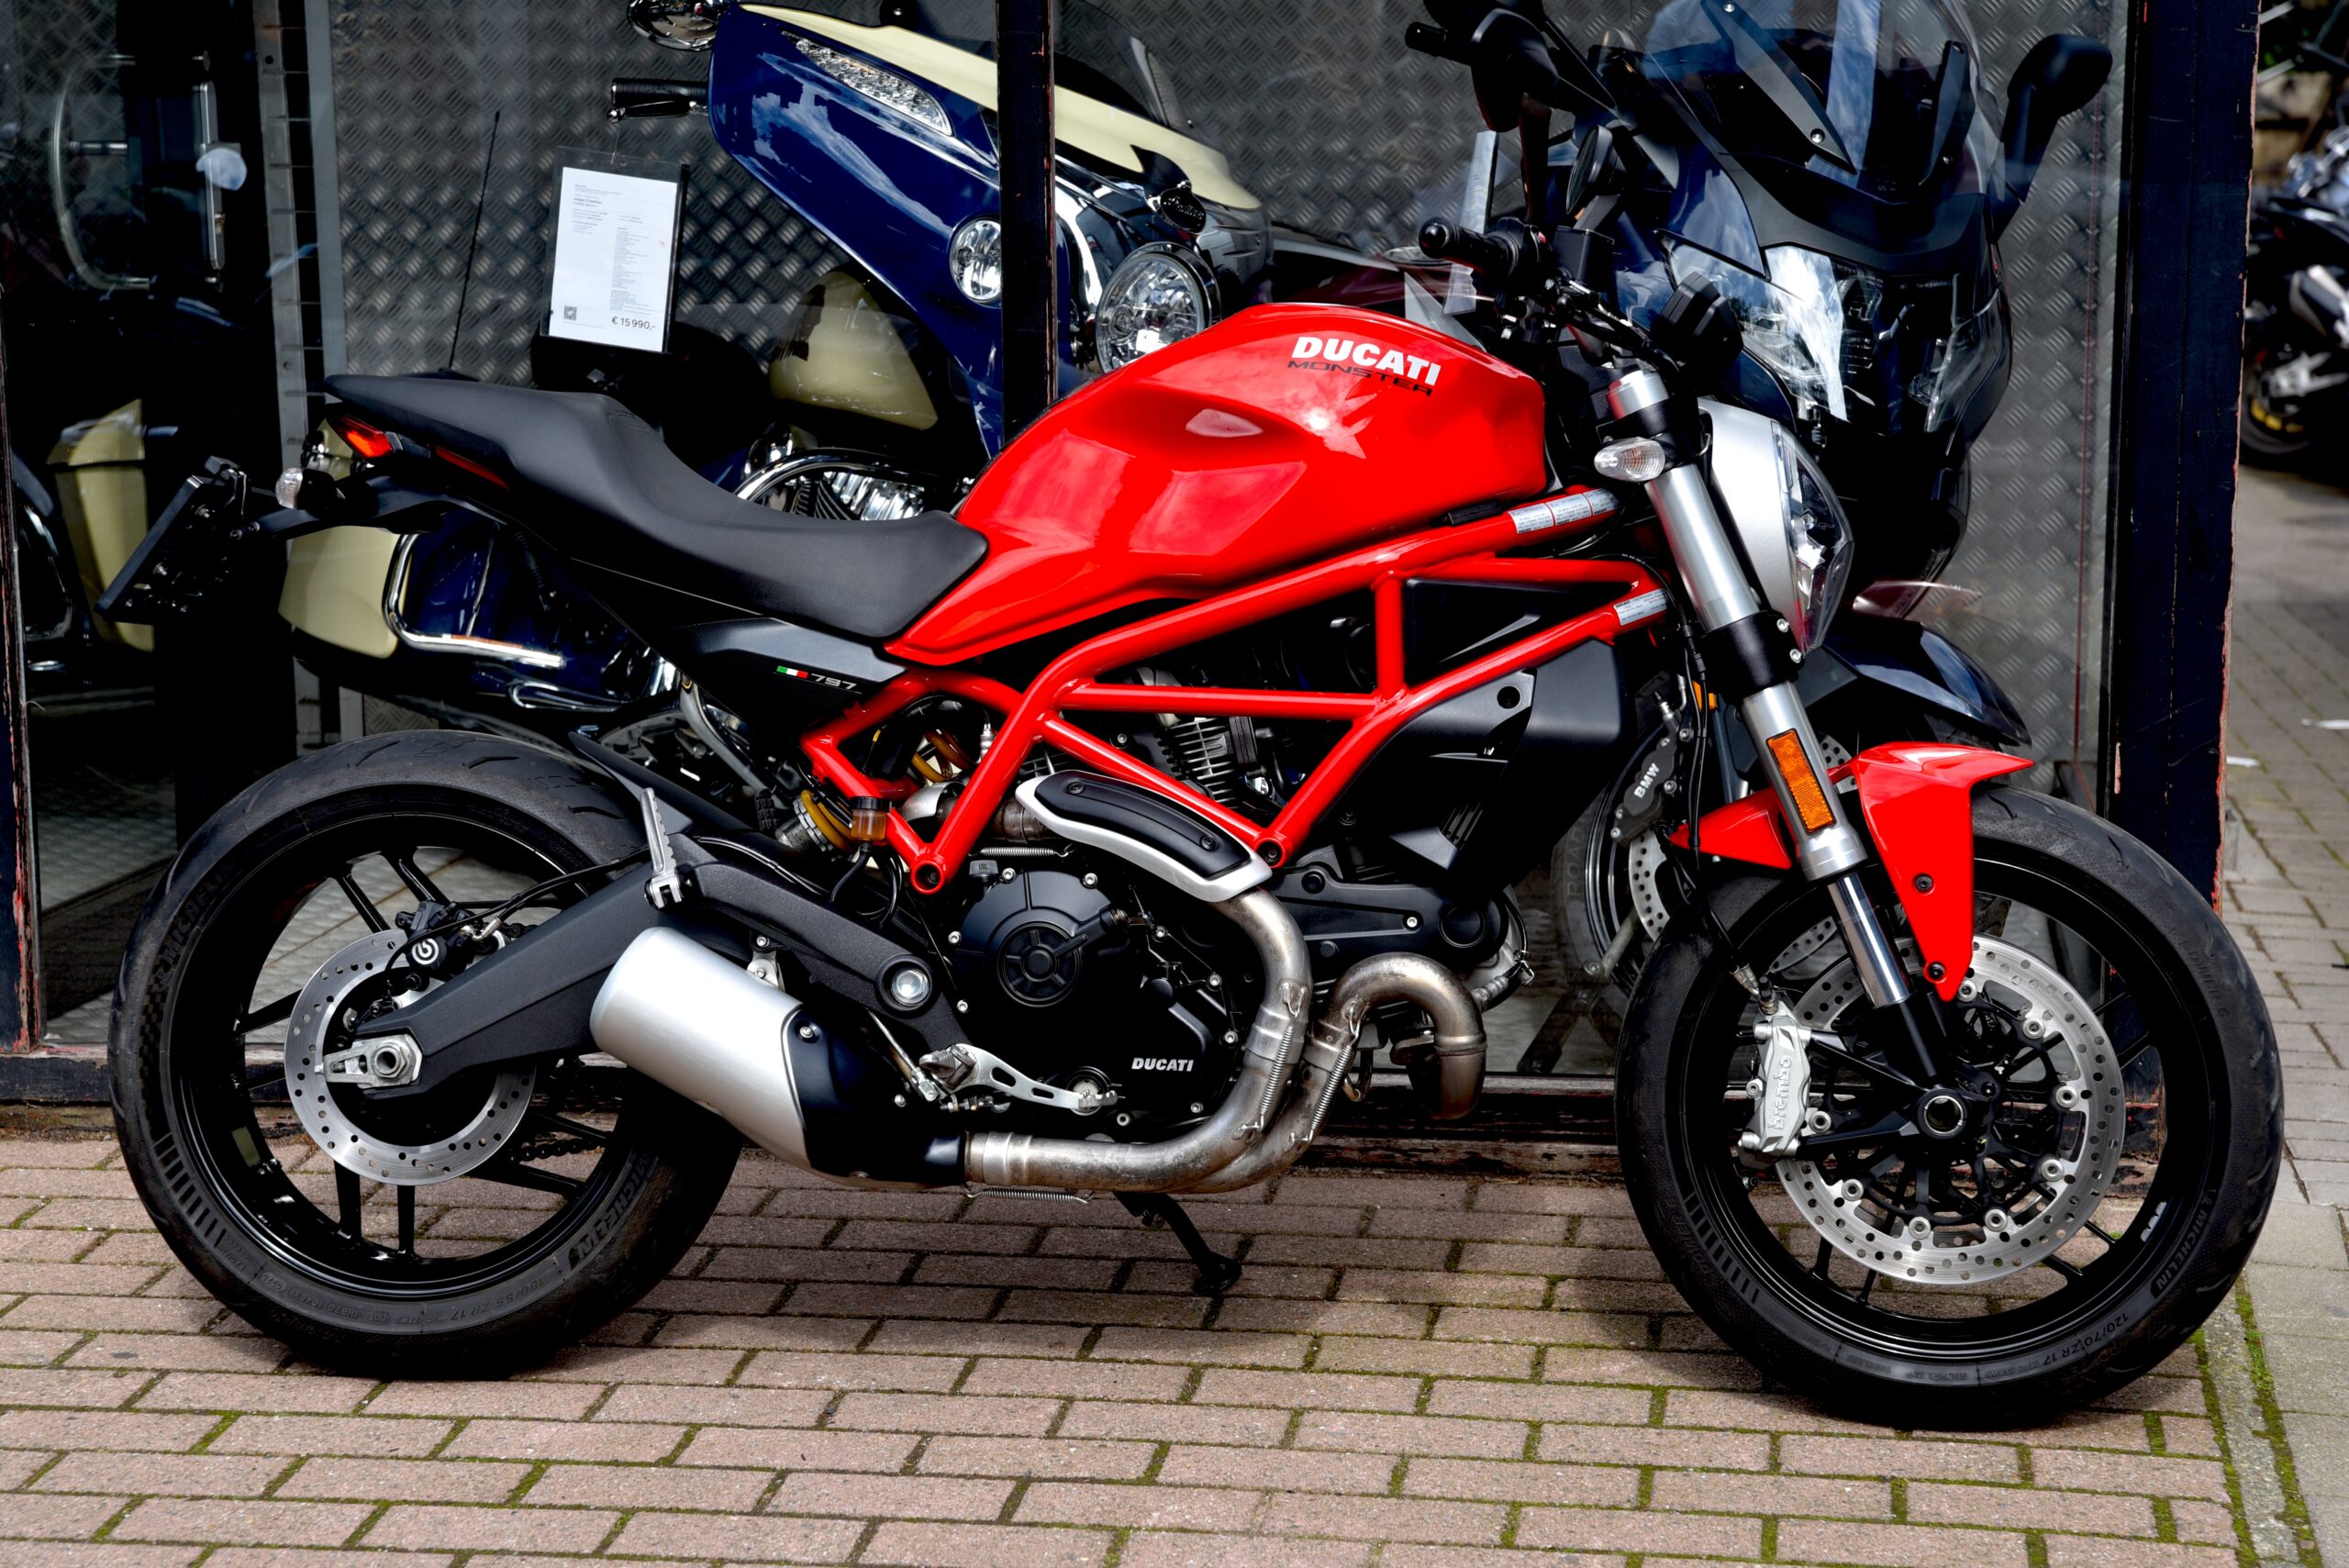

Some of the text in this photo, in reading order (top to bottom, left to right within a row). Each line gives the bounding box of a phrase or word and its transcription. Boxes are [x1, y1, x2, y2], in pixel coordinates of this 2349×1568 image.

[1287, 361, 1434, 396] MONSTER
[1292, 337, 1442, 386] DUCATI
[811, 673, 857, 690] 797
[1633, 762, 1660, 798] BMW
[1131, 1057, 1194, 1072] DUCATI
[1768, 1056, 1792, 1130] brembo
[576, 1154, 651, 1260] MICHELIN
[2156, 1207, 2209, 1291] MICHELIN
[2082, 1313, 2129, 1348] 120/70
[2043, 1352, 2057, 1365] 17
